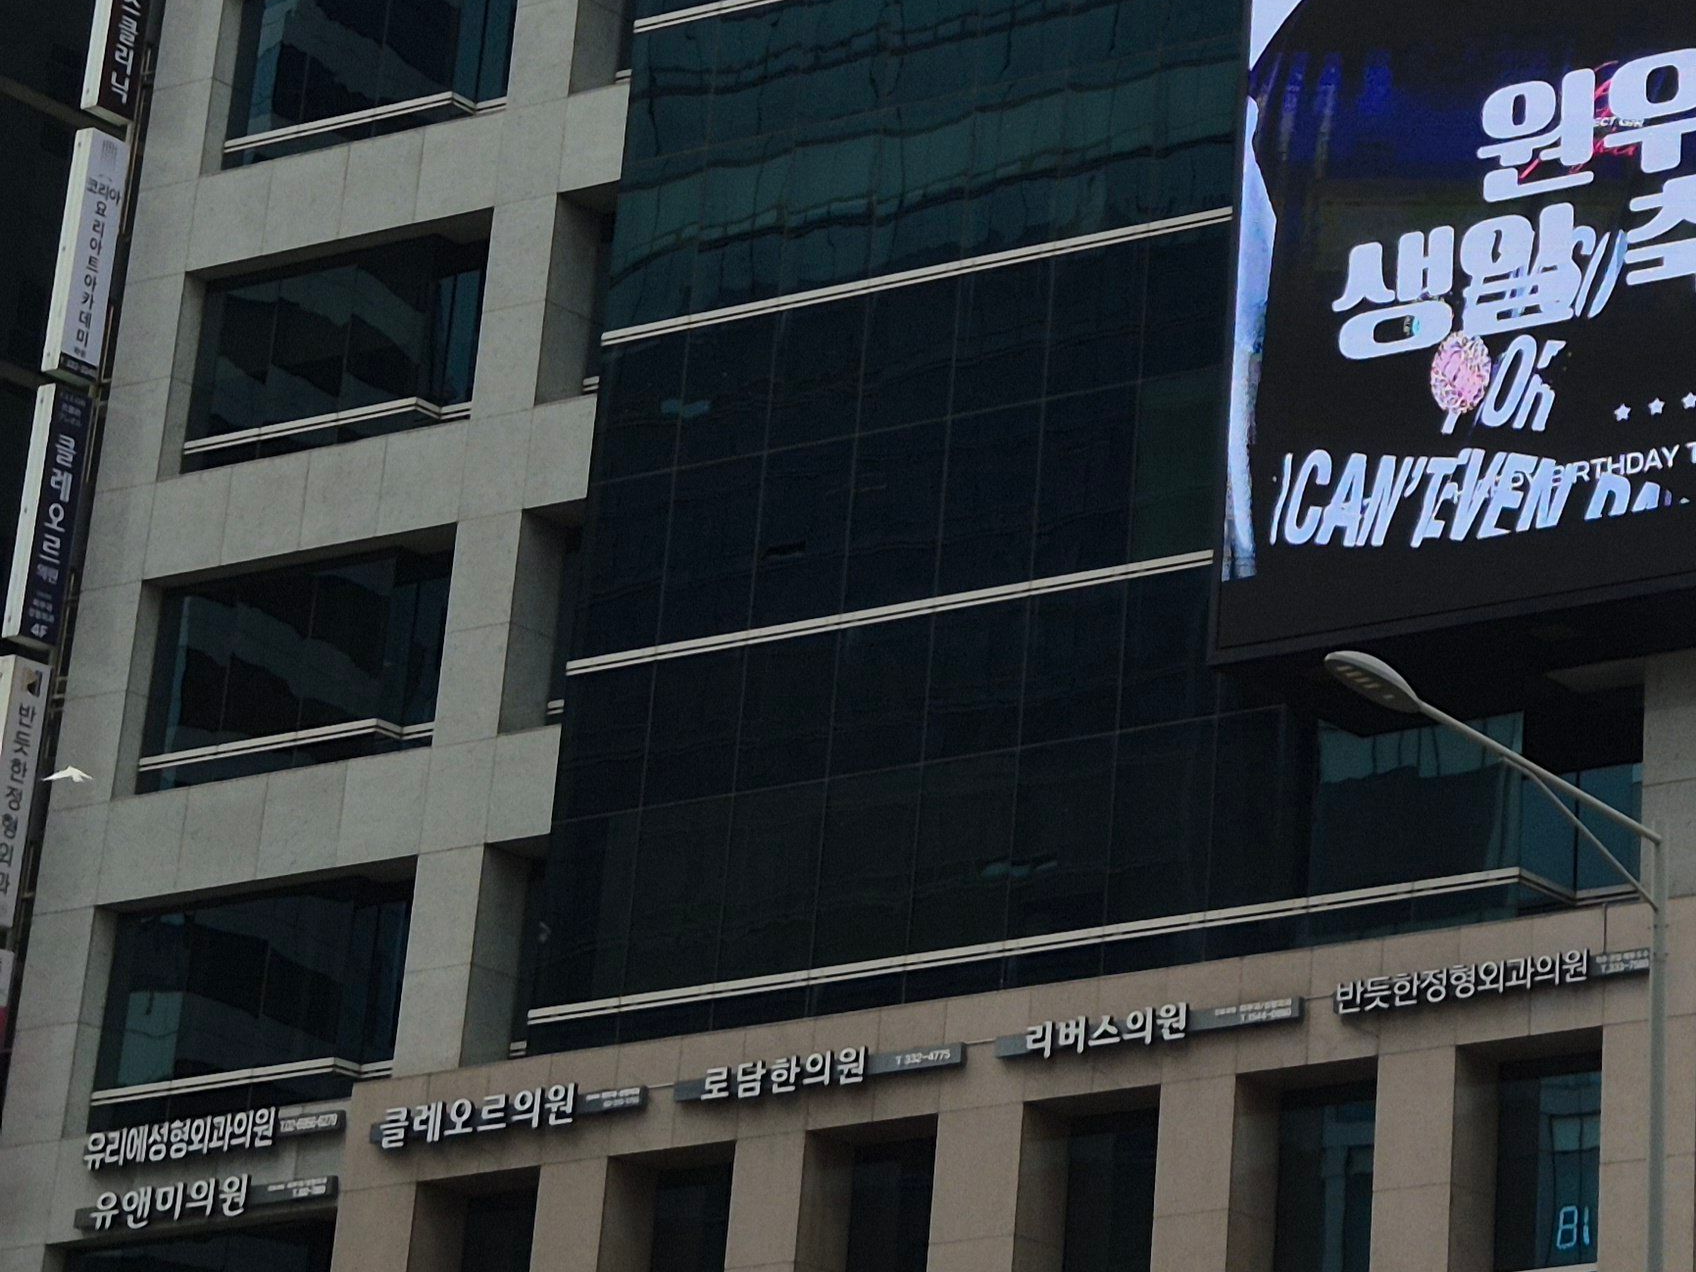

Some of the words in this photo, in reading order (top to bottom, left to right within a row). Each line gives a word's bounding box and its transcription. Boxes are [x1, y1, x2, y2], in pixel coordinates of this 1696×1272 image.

[86, 177, 121, 207] 코리아
[38, 433, 77, 565] 클레오르
[1336, 948, 1591, 1015] 반듯한정형외과의원
[1025, 1002, 1188, 1059] 리버스의원
[700, 1046, 867, 1101] 로담한의원
[83, 1106, 276, 1170] 유리에성형외과의원
[380, 1082, 577, 1149] 클레오르의원
[90, 1173, 248, 1230] 유앤미의원
